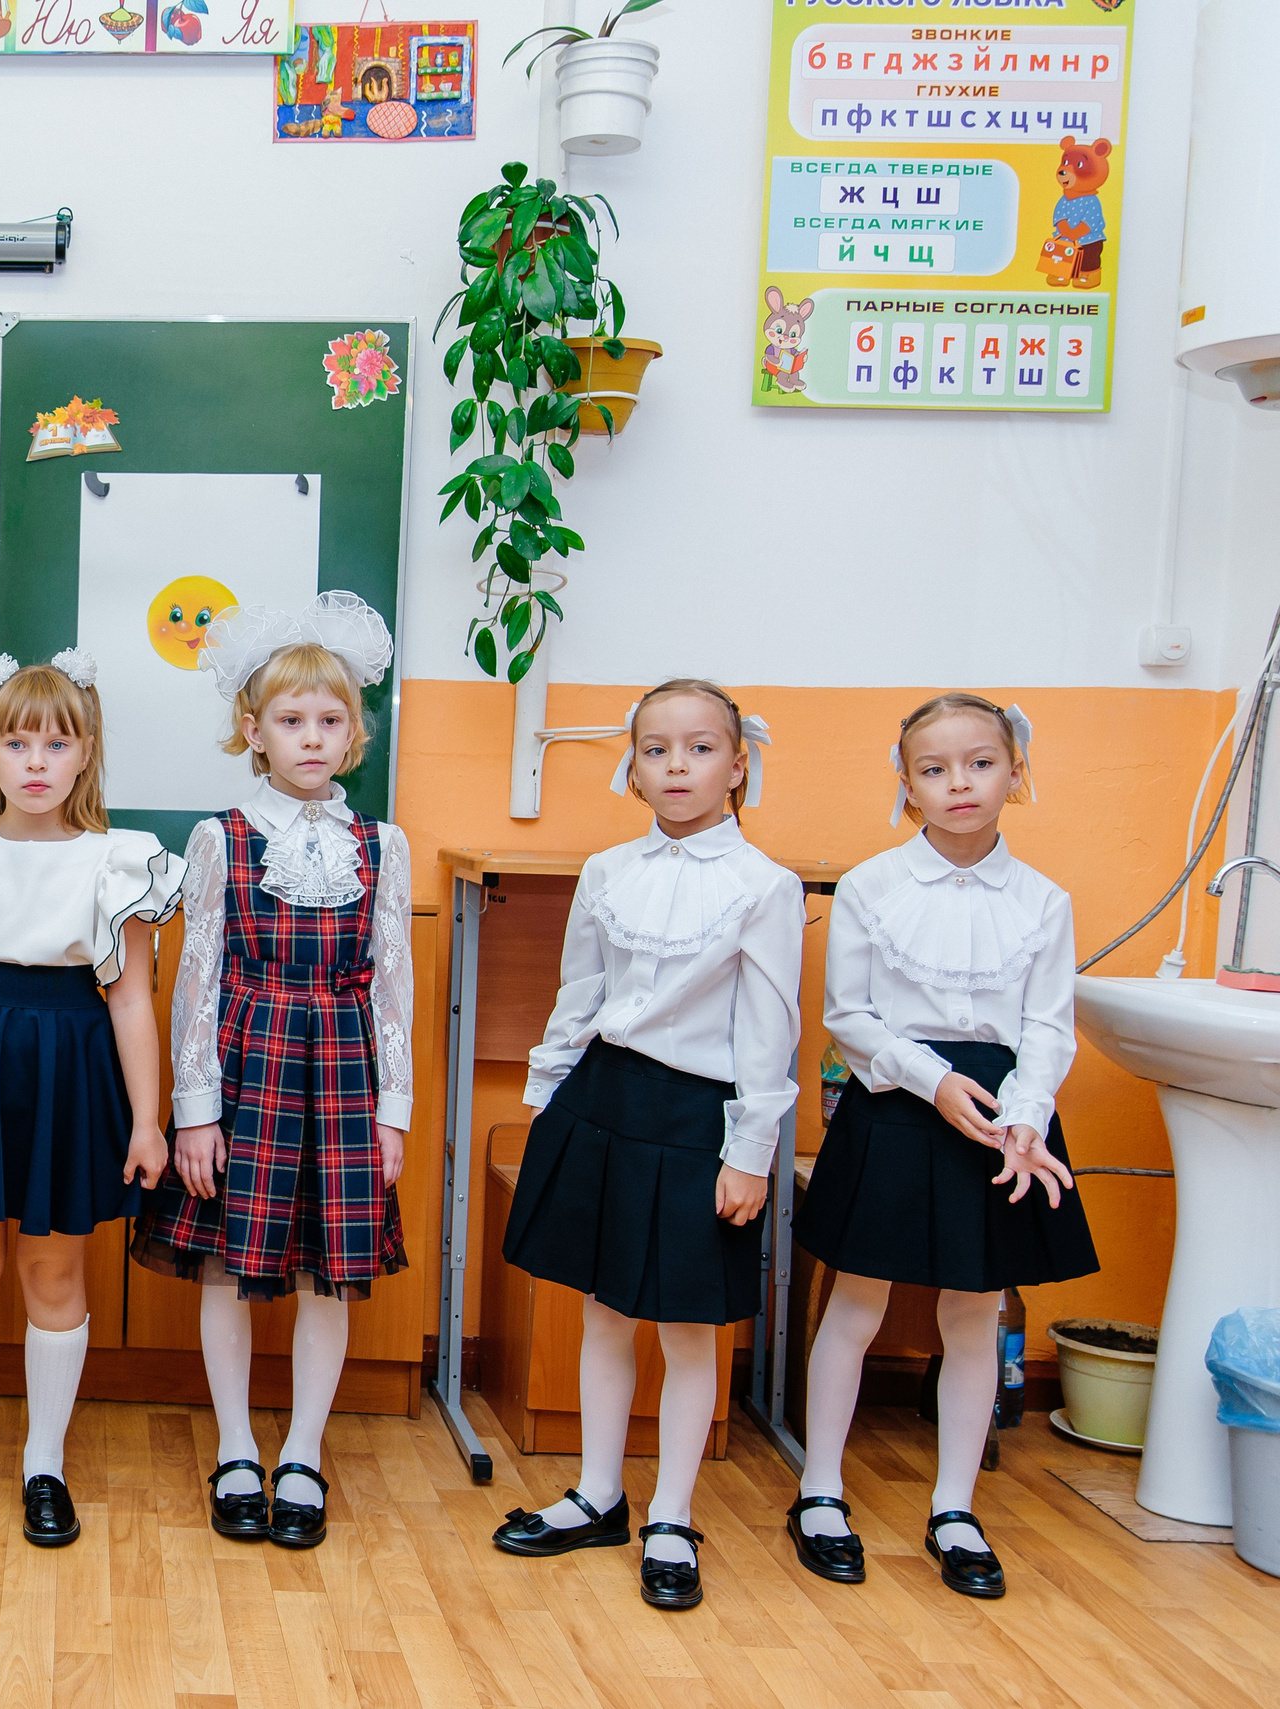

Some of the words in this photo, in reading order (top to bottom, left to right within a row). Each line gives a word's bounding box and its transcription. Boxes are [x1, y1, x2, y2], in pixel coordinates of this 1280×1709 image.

[911, 29, 1012, 41] ЗВОНКИЕ
[916, 85, 1000, 97] ГЛУХИЕ
[790, 162, 878, 175] ВСЕГДА
[888, 163, 993, 176] ТВЕРДЫЕ
[793, 217, 881, 230] ВСЕГДА
[891, 218, 984, 231] МЯГКИЕ
[846, 300, 945, 313] ПАРНЫЕ
[954, 302, 1099, 316] СОГЛАСНЫЕ
[856, 325, 876, 353] б
[899, 335, 915, 353] в
[943, 336, 956, 354] г
[981, 337, 1000, 359] д
[1019, 337, 1046, 356] ж
[1067, 338, 1083, 357] з
[855, 364, 873, 383] п
[892, 359, 919, 391] ф
[938, 366, 955, 384] к
[982, 367, 996, 385] т
[1018, 367, 1043, 386] ш
[1064, 368, 1081, 387] с
[48, 425, 58, 437] 1
